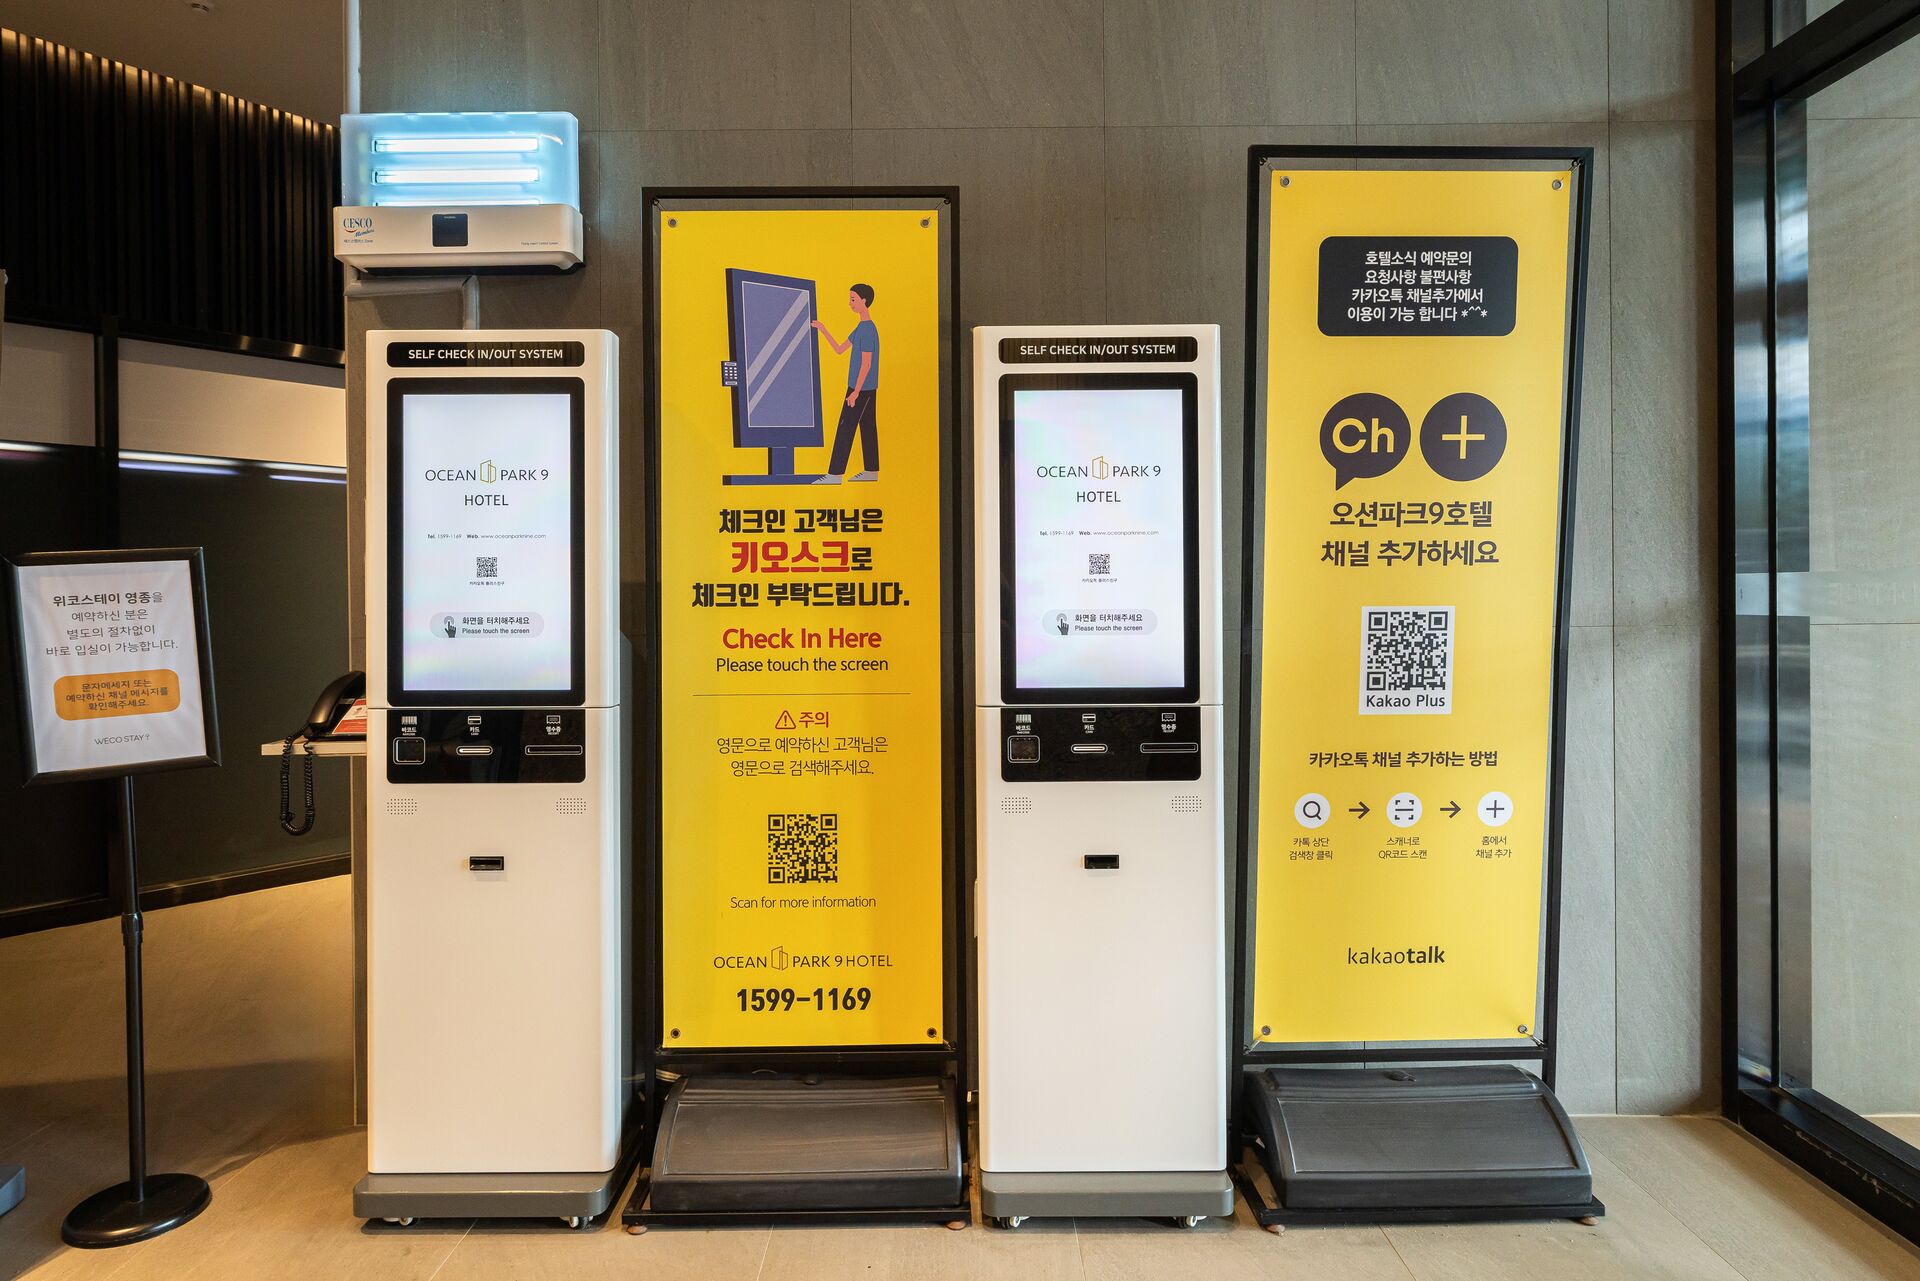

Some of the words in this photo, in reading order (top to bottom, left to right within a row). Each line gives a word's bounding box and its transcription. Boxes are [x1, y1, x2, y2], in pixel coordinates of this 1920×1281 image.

[342, 217, 373, 229] CESCO
[1365, 251, 1417, 266] 호텔소식
[1420, 251, 1472, 266] 예약문의
[1364, 269, 1417, 285] 요청사항
[1420, 269, 1472, 285] 불편사항
[1351, 288, 1403, 304] 카카오톡
[1406, 288, 1483, 304] 채널추가에서
[1347, 307, 1386, 322] 이용이
[1390, 307, 1415, 322] 가능
[1419, 307, 1457, 322] 합니다
[408, 349, 435, 359] SELF
[437, 349, 475, 359] CHECK
[477, 349, 517, 360] IN/OUT
[519, 349, 563, 359] SYSTEM
[1020, 344, 1047, 355] SELF
[1049, 344, 1087, 355] CHECK
[1089, 344, 1129, 356] IN/OUT
[1131, 344, 1176, 354] SYSTEM
[1332, 417, 1395, 453] Ch
[425, 469, 477, 482] OCEAN
[500, 469, 537, 481] PARK
[540, 469, 549, 481] 9
[1036, 465, 1088, 478] OCEAN
[1112, 465, 1149, 477] PARK
[1153, 465, 1161, 477] 9
[464, 494, 509, 507] HOTEL
[1076, 490, 1121, 503] HOTEL
[719, 509, 785, 534] 체크인
[793, 508, 883, 533] 고객님은
[1330, 500, 1493, 528] 오션파크9호텔
[731, 540, 873, 573] 키오스크로
[1321, 541, 1369, 566] 채널
[1377, 540, 1499, 566] 추가하세요
[53, 592, 120, 607] 위코스테이
[125, 591, 163, 605] 영종을
[692, 583, 759, 608] 체크인
[767, 582, 910, 607] 부탁드립니다.
[71, 610, 121, 622] 예약하신
[124, 608, 149, 621] 분은
[462, 617, 484, 625] 화면을
[486, 616, 530, 625] 터치해주세요
[1075, 614, 1097, 622] 화면을
[1099, 613, 1143, 622] 터치해주세요
[66, 628, 104, 640] 별도의
[107, 625, 156, 639] 절차없이
[722, 628, 794, 649] Check
[801, 628, 822, 649] In
[829, 628, 882, 649] Here
[46, 645, 71, 657] 바로
[75, 643, 112, 656] 입실이
[115, 639, 178, 655] 가능합니다.
[716, 658, 763, 672] Please
[767, 658, 809, 672] touch
[813, 657, 837, 671] the
[841, 659, 888, 671] screen
[133, 679, 152, 688] 또는
[65, 691, 105, 703] 예약하신
[1366, 695, 1411, 708] Kakao
[1416, 694, 1446, 707] Plus
[799, 711, 829, 729] 주의
[716, 737, 772, 754] 영문으로
[775, 737, 830, 754] 예약하신
[834, 736, 888, 753] 고객님은
[1309, 752, 1369, 768] 카카오톡
[1372, 752, 1401, 768] 채널
[1405, 751, 1465, 768] 추가하는
[1469, 751, 1498, 767] 방법
[731, 760, 786, 777] 영문으로
[789, 759, 874, 777] 검색해주세요.
[1293, 837, 1310, 847] 카톡
[1313, 837, 1329, 847] 상단
[1386, 836, 1420, 846] 스캐너로
[1481, 836, 1507, 846] 홈에서
[1289, 850, 1314, 860] 검색창
[1316, 850, 1333, 860] 클릭
[1378, 850, 1408, 859] QR코드
[1410, 849, 1427, 859] 스캔
[1475, 849, 1492, 859] 채널
[1495, 848, 1512, 858] 추가
[730, 897, 758, 908] Scan
[761, 896, 776, 908] for
[779, 898, 809, 908] more
[812, 896, 877, 908] information
[713, 956, 767, 969] OCEAN
[792, 956, 830, 968] PARK
[834, 956, 843, 968] 9
[846, 955, 893, 967] HOTEL
[1348, 946, 1445, 964] kakaotalk
[737, 988, 871, 1012] 1599-1169
